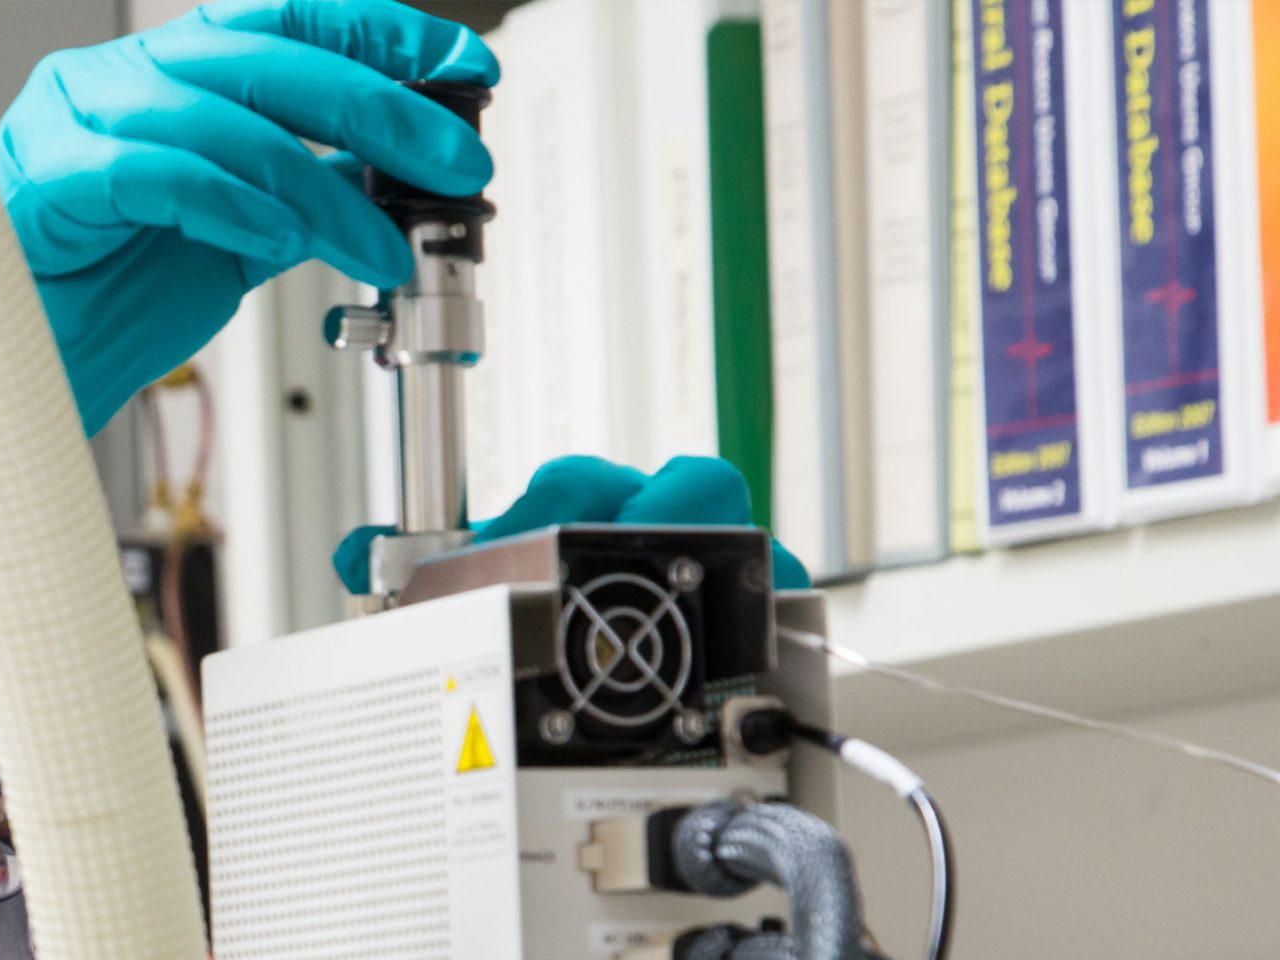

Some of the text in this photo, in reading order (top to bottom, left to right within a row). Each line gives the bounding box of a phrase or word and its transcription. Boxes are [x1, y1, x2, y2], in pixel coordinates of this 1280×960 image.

[983, 81, 1017, 292] Database
[1123, 23, 1159, 245] Database
[1180, 399, 1216, 432] 2007
